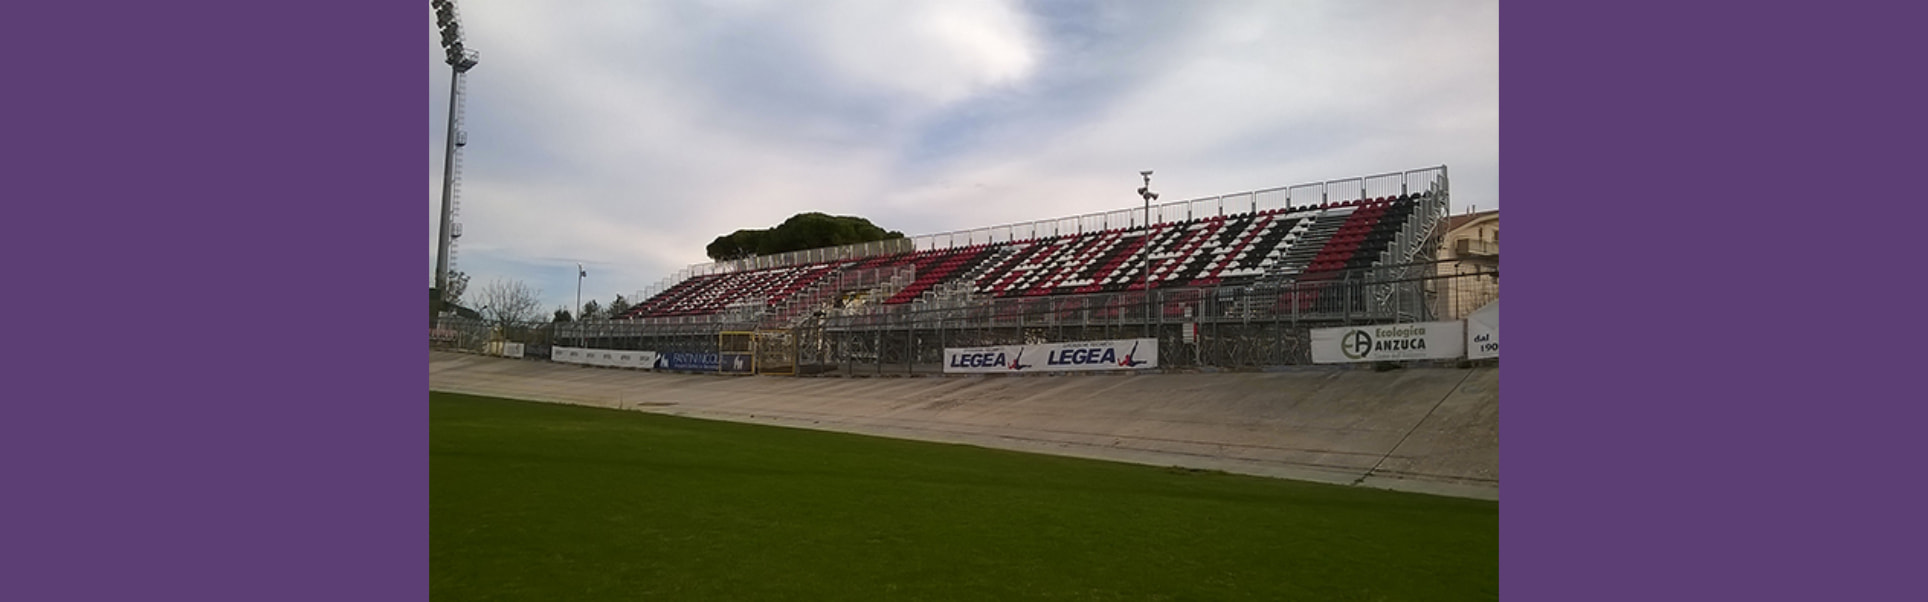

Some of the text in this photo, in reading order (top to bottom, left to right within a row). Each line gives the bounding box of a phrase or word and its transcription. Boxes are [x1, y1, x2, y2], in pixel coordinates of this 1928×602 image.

[1375, 325, 1426, 338] Ecologica
[1474, 333, 1489, 342] dal
[1375, 338, 1426, 351] ANZUCA
[951, 352, 1006, 368] LEGEA
[1047, 347, 1116, 365] LEGEA
